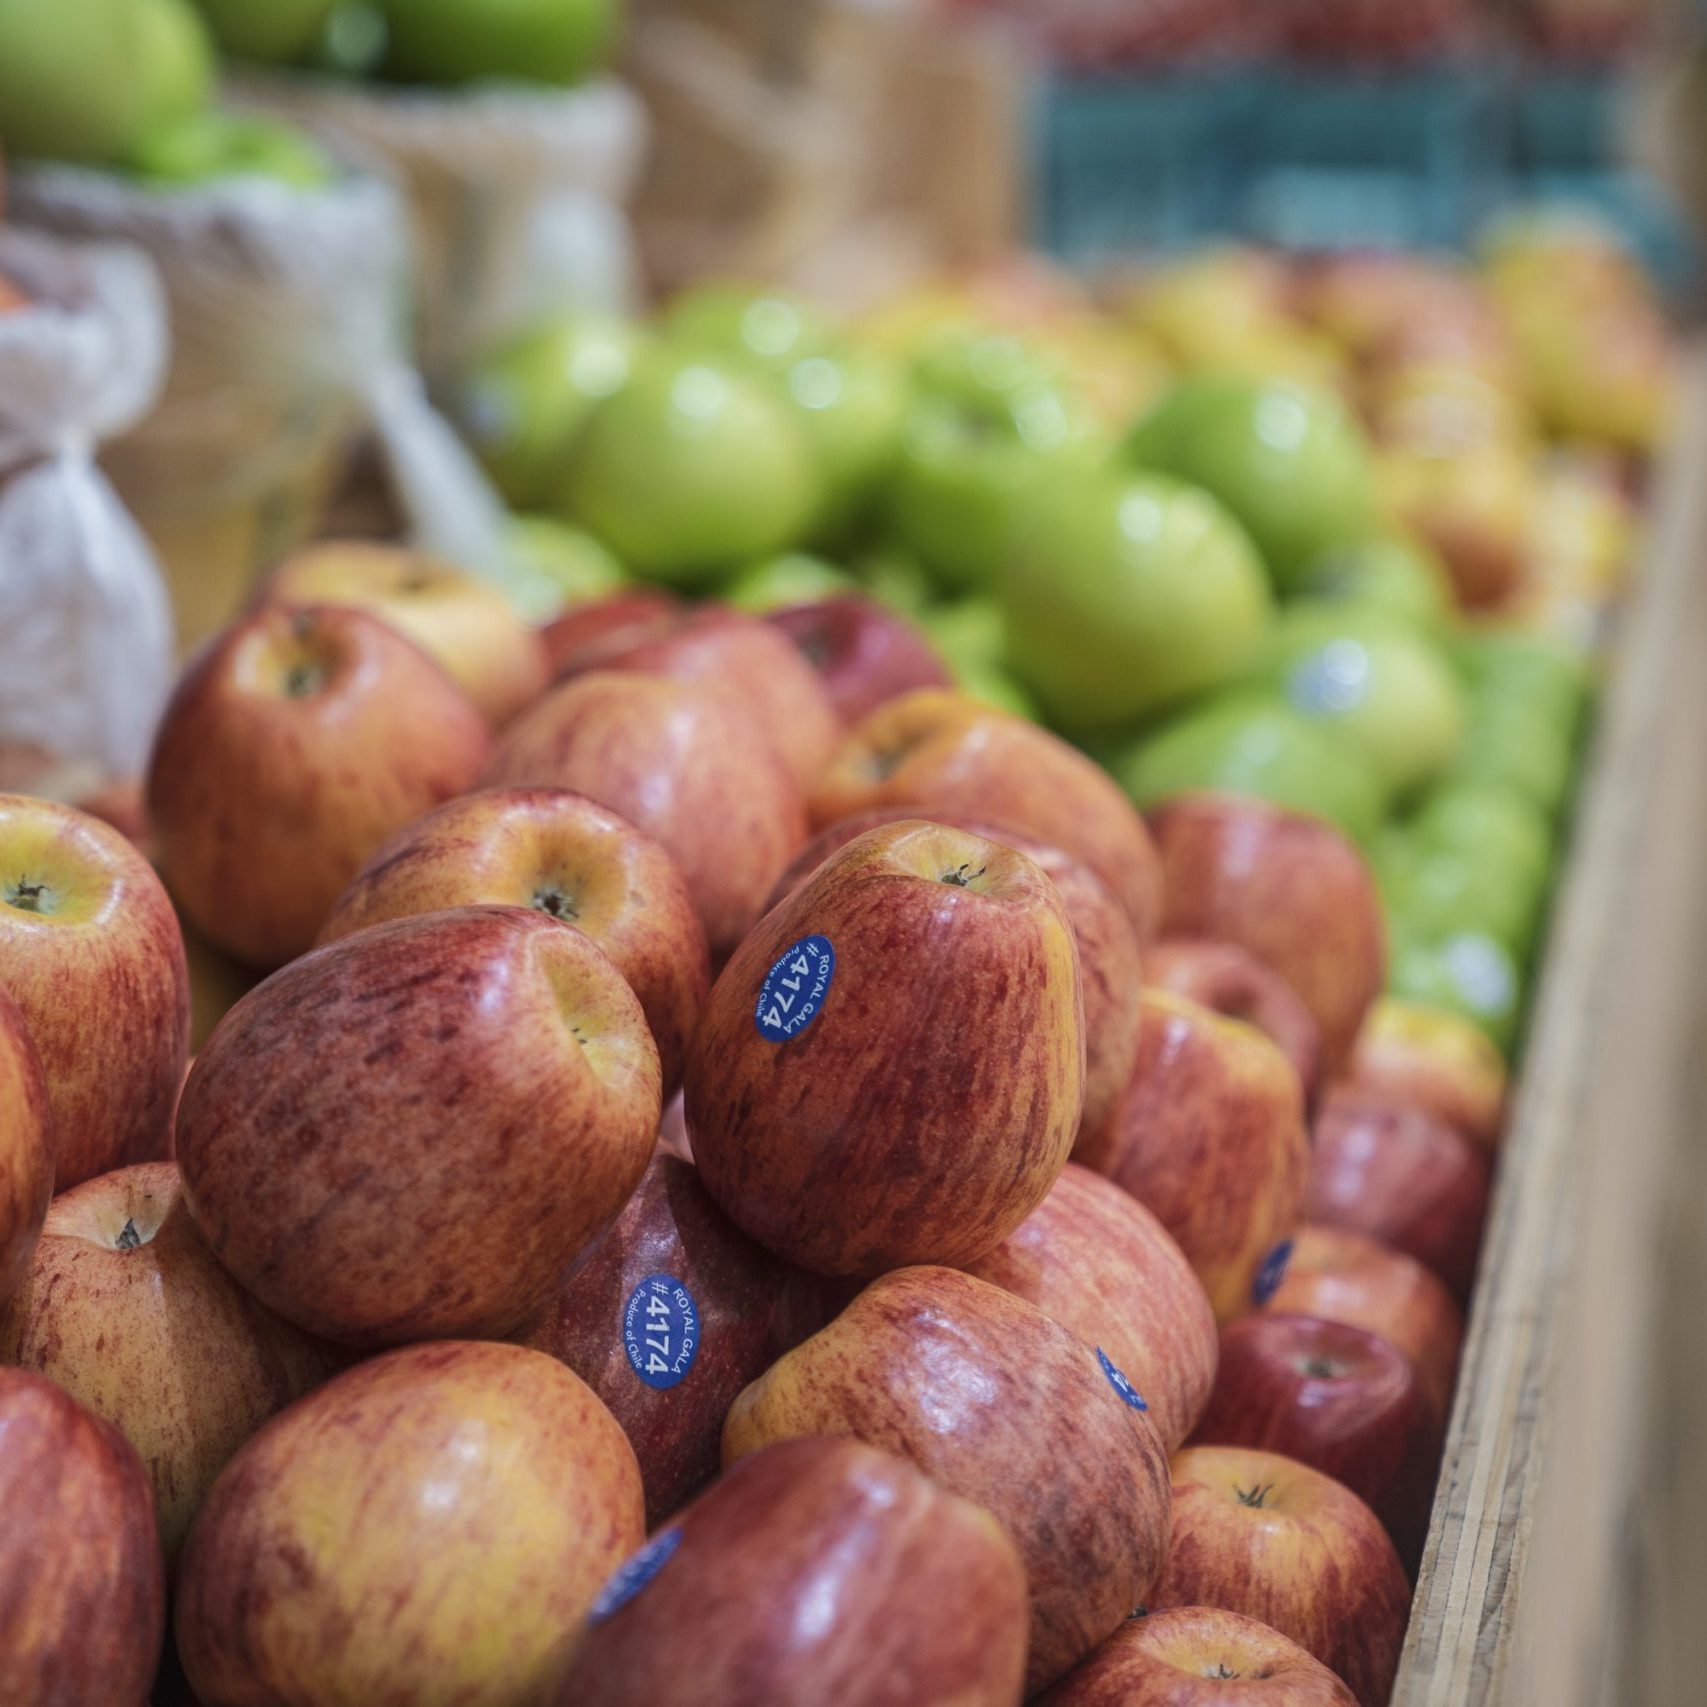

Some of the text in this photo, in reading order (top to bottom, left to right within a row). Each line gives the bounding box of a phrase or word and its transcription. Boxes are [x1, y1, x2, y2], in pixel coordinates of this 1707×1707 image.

[756, 946, 800, 1017] Produce of Chile
[783, 954, 830, 1034] ROYAL GALA
[626, 1288, 646, 1369] Produce of Chile
[671, 1287, 695, 1374] ROYAL GALA
